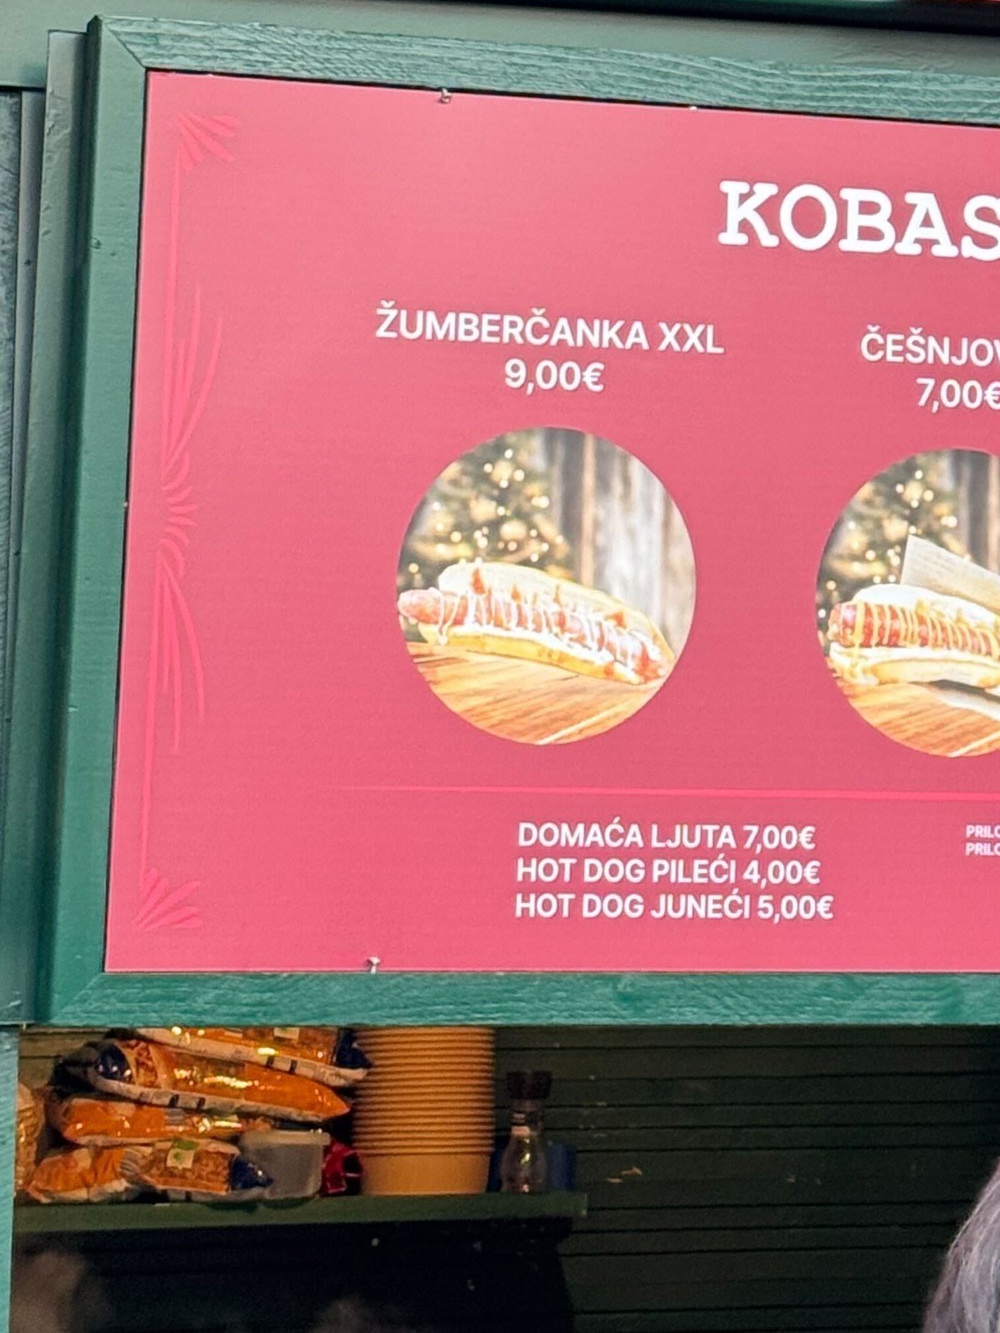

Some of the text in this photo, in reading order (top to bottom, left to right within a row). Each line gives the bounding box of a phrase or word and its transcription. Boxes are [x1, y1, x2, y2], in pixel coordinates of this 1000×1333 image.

[375, 299, 725, 354] ŽUMBERČANKA XXL
[504, 357, 605, 395] 9,00€
[518, 816, 816, 854] DOMAĆA LJUTA 7,00€
[516, 852, 821, 889] HOT DOG PILEĆI 4,00€
[515, 888, 834, 924] HOT DOG JUNEĆI 5,00€
